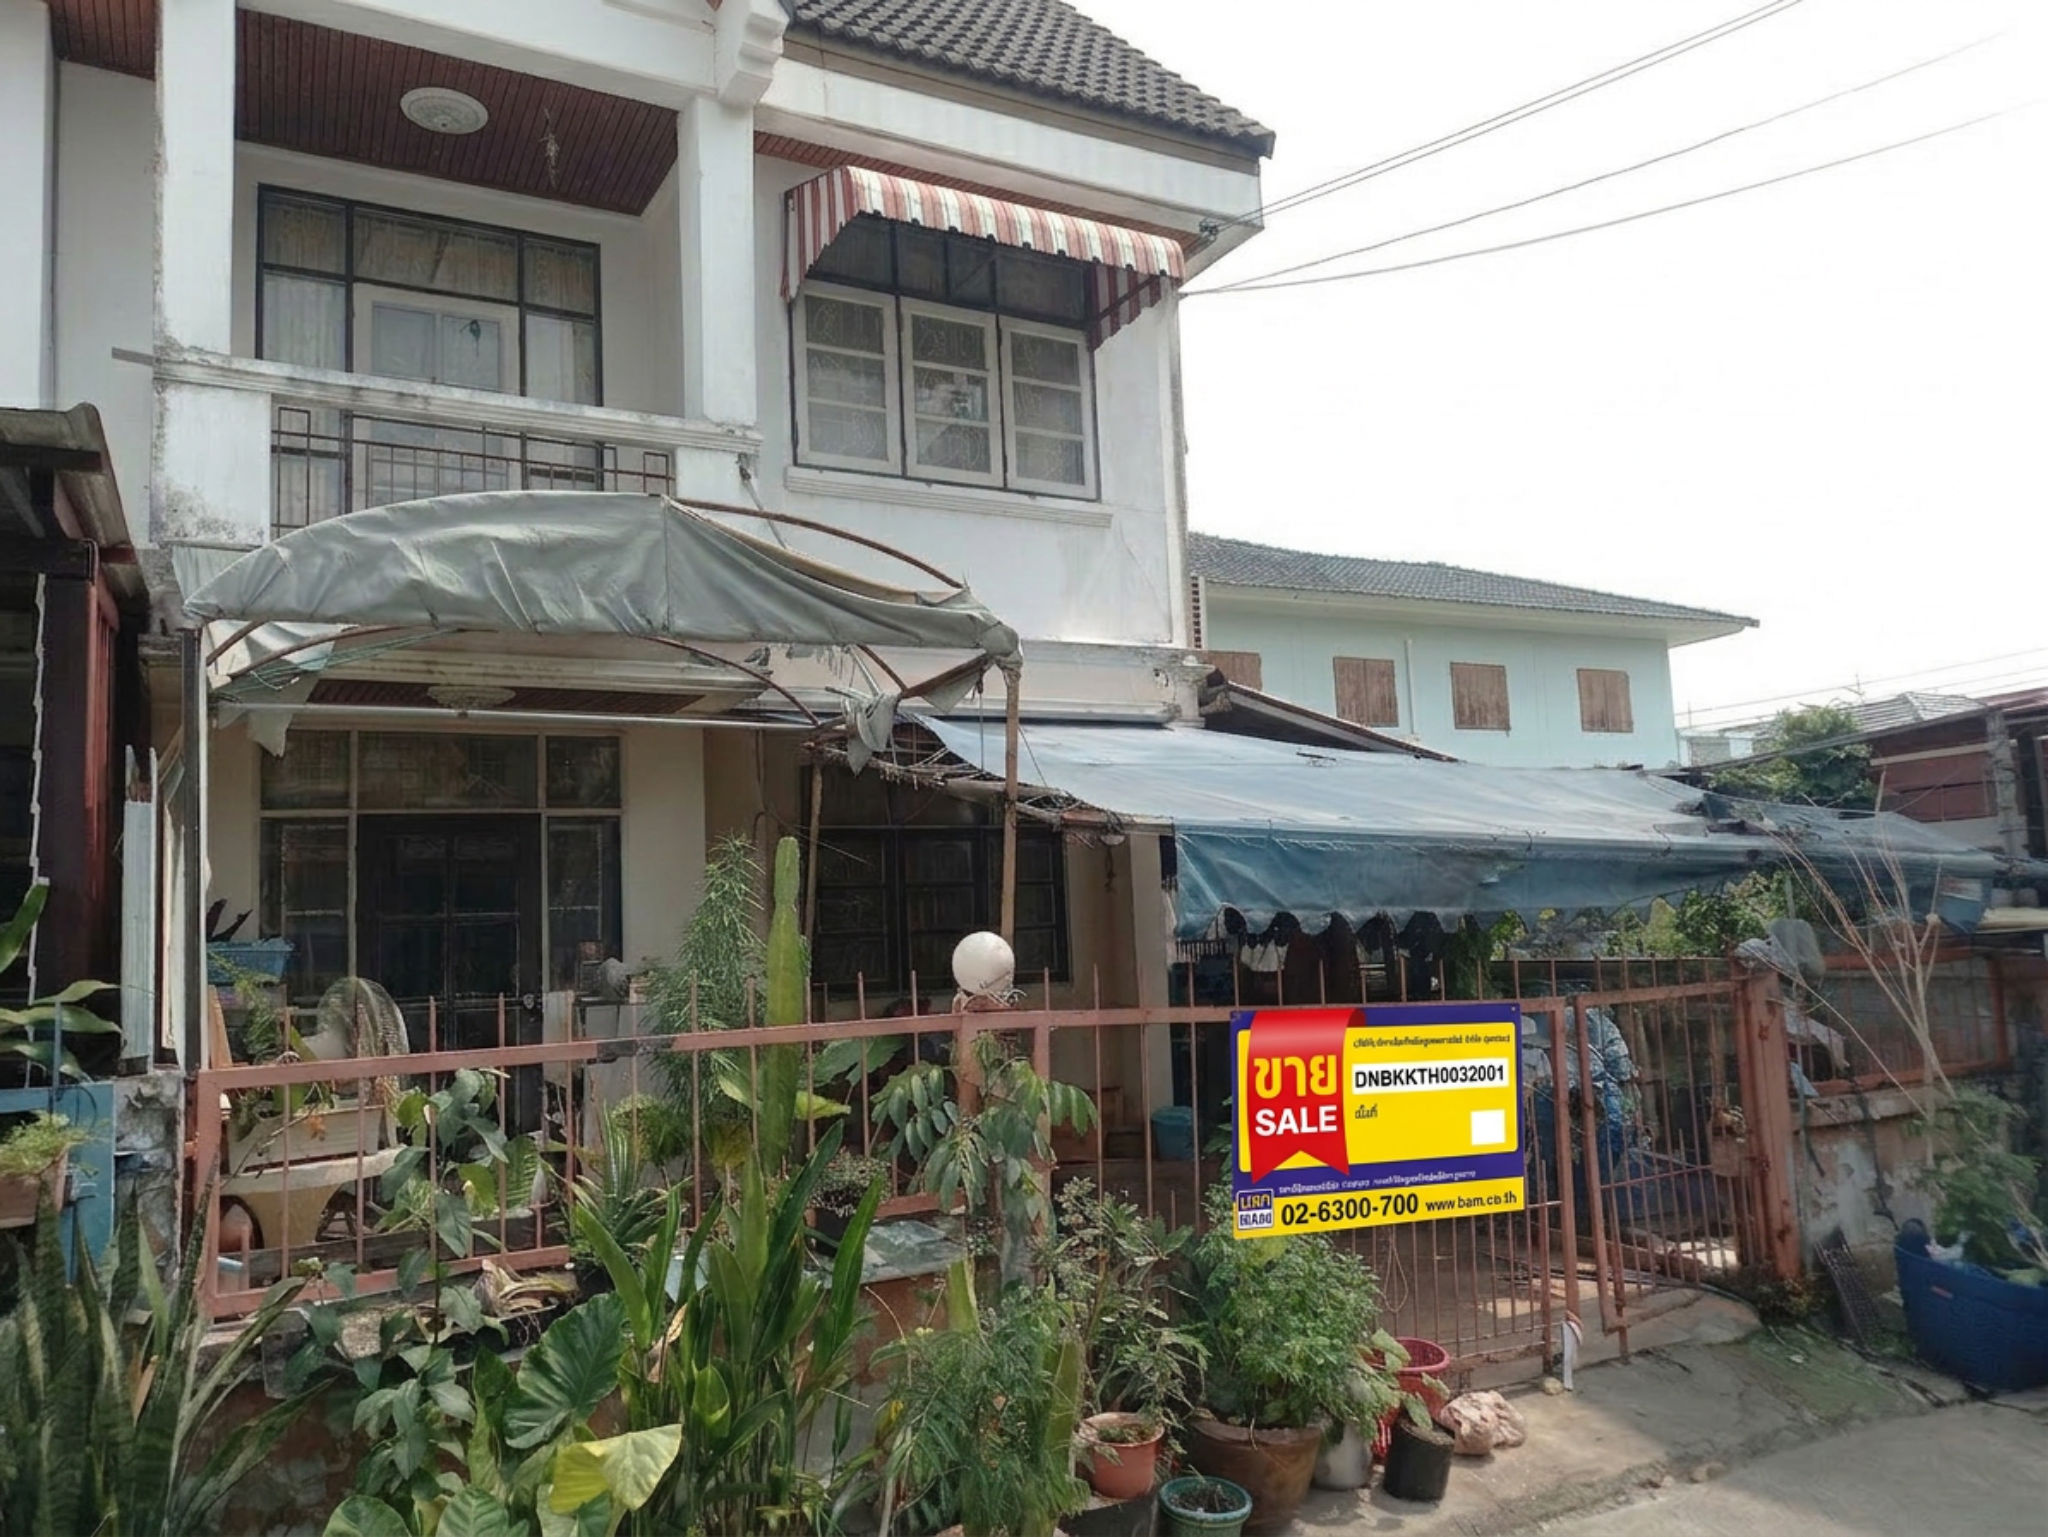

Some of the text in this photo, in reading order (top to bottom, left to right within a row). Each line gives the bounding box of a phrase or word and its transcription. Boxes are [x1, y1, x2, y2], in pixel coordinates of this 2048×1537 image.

[1253, 1054, 1337, 1099] ขาย
[1355, 1064, 1504, 1089] DNBKKTH0032001
[1255, 1105, 1338, 1137] SALE
[1281, 1193, 1418, 1226] 02-6300-700
[1425, 1190, 1517, 1212] wwwbam.coth
